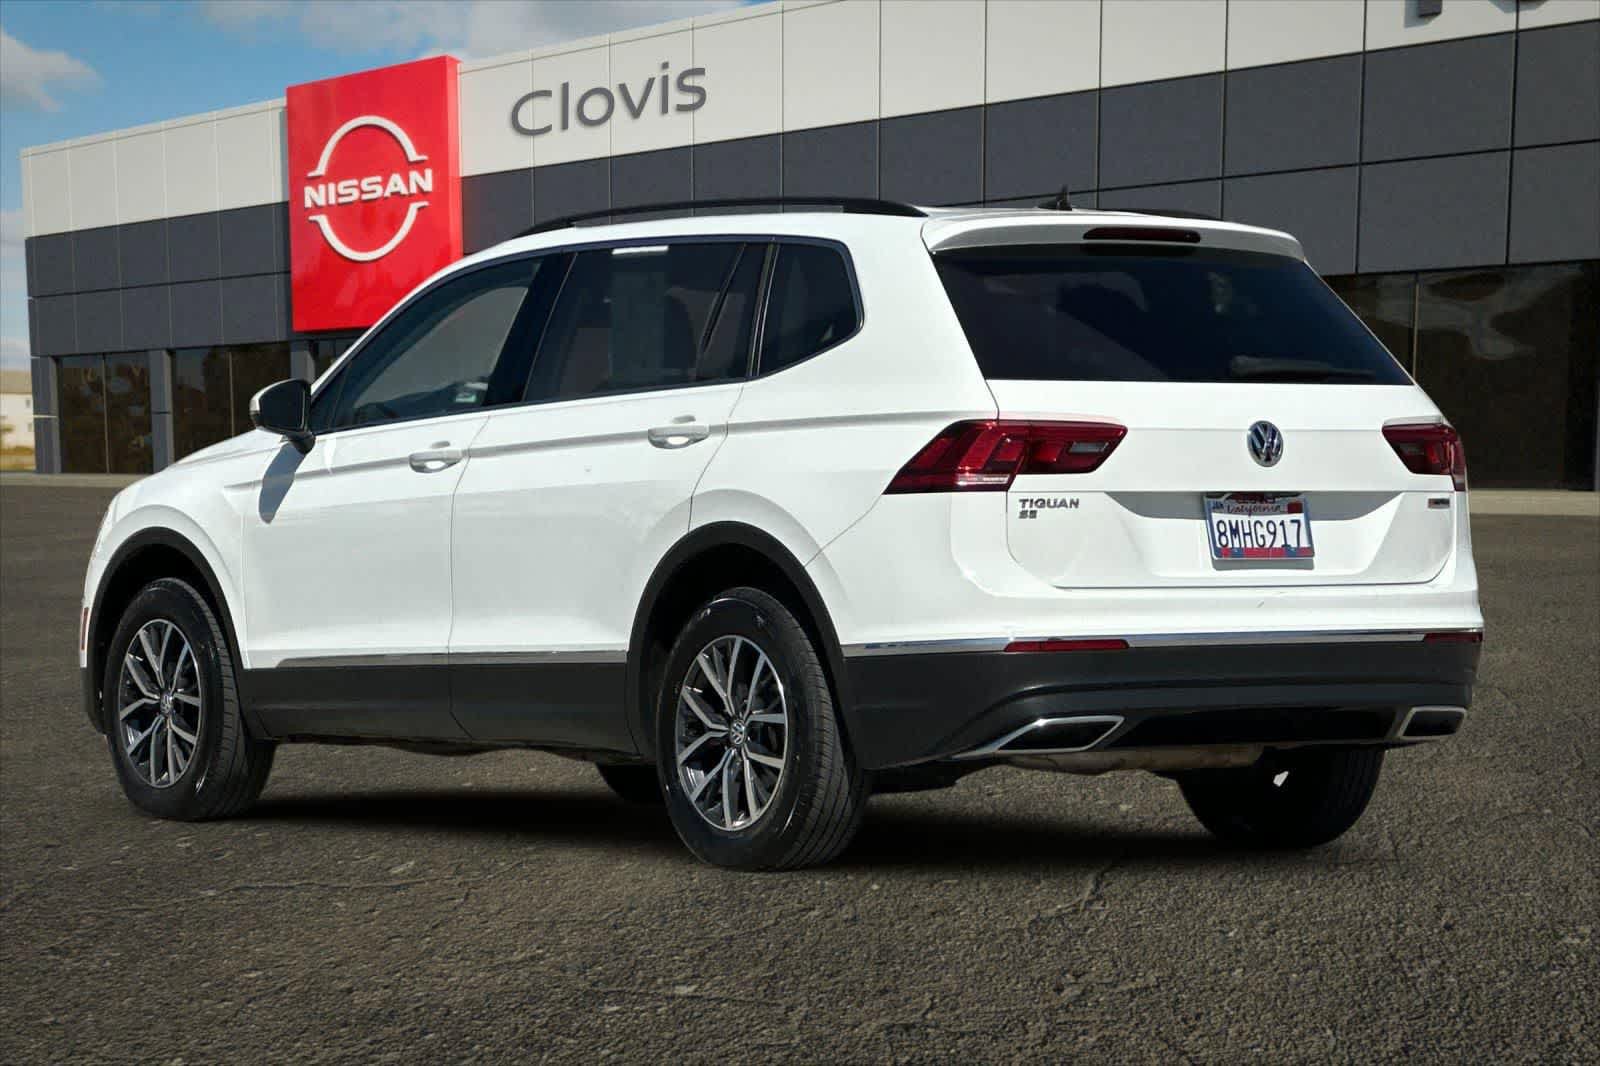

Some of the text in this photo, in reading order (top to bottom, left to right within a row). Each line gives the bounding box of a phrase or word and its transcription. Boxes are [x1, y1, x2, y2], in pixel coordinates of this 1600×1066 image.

[511, 61, 707, 136] Clovis
[303, 168, 433, 209] NISSAN
[1018, 498, 1080, 509] TIGUAN
[1227, 502, 1281, 517] California
[1216, 519, 1301, 548] 8MHG917
